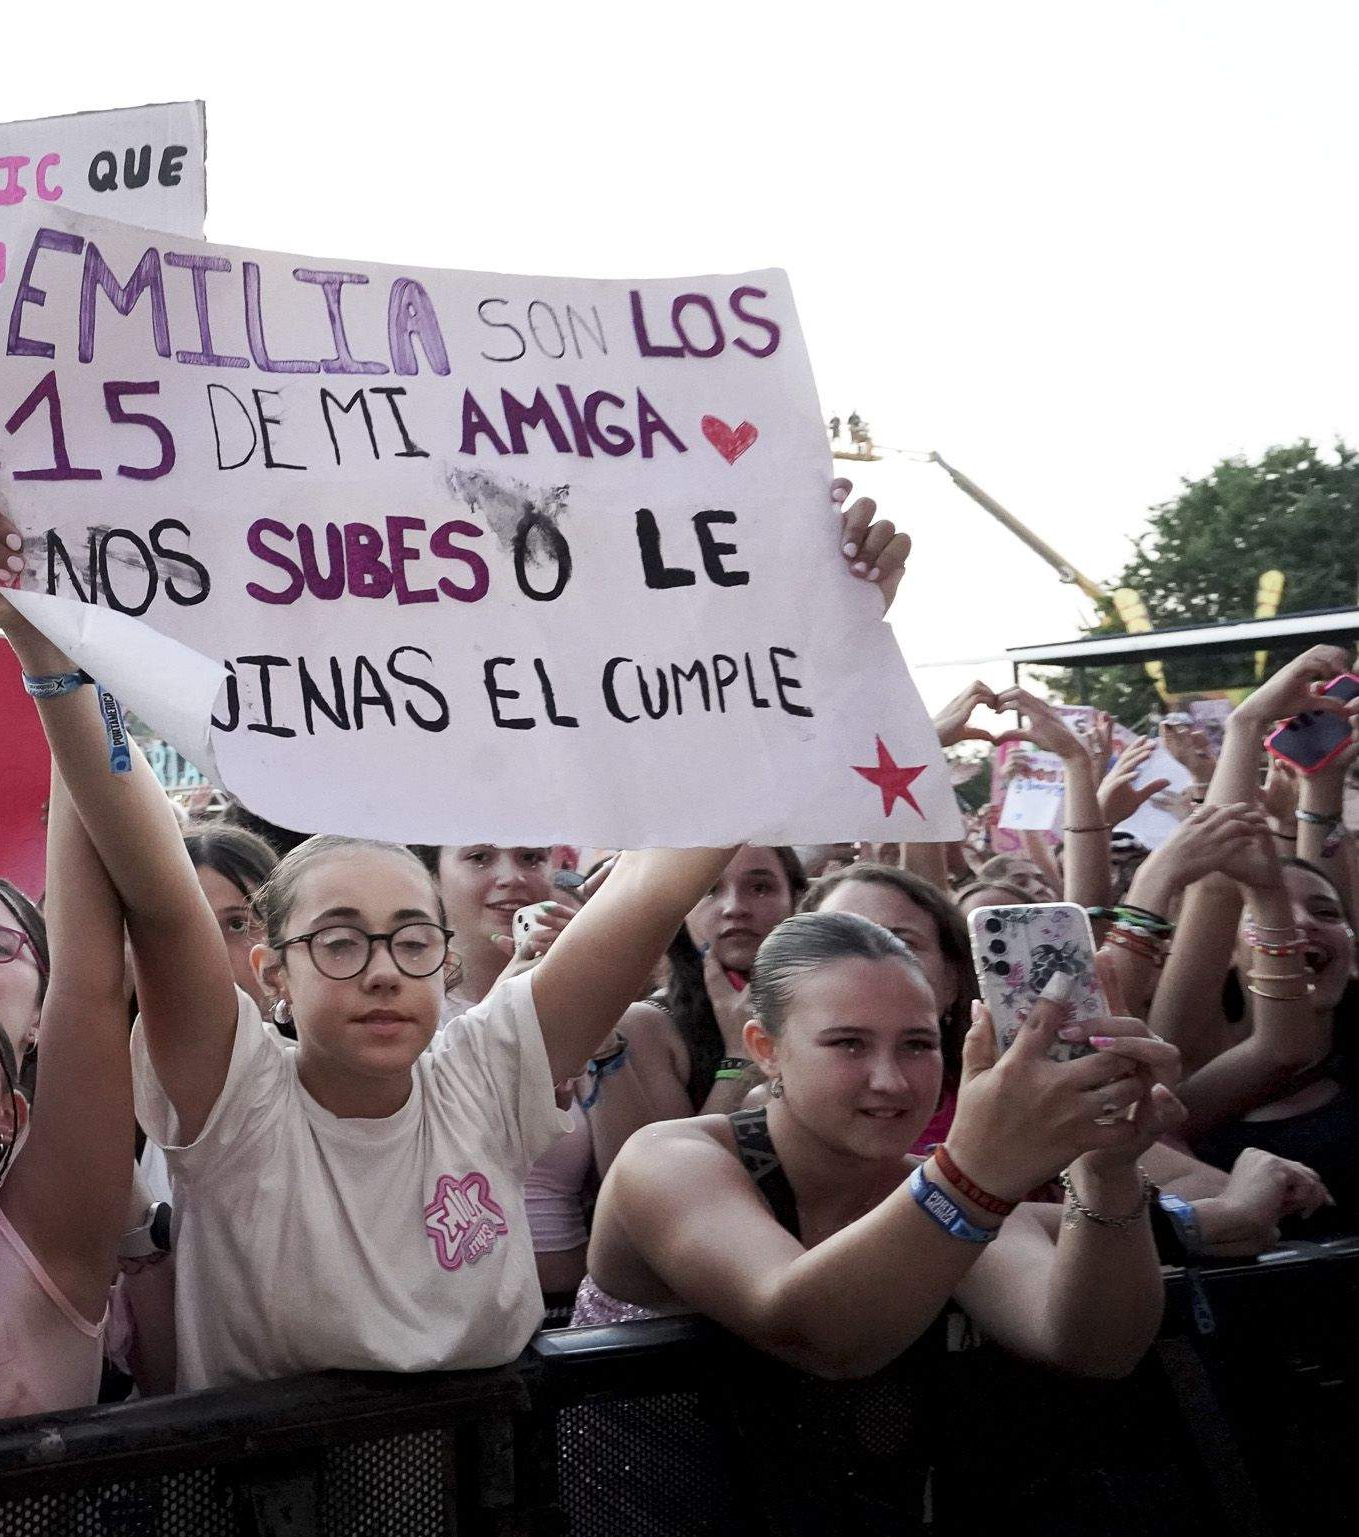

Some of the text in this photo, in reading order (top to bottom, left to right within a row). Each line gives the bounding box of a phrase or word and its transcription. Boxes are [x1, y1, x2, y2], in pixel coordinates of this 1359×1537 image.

[88, 145, 188, 192] QUE
[6, 228, 782, 376] EMILIA SON LOS
[4, 370, 687, 482] 15 DE MI AMIGA
[46, 508, 751, 617] NOS SUBES O LE
[484, 656, 580, 730] EL
[602, 646, 814, 724] CUMPLE
